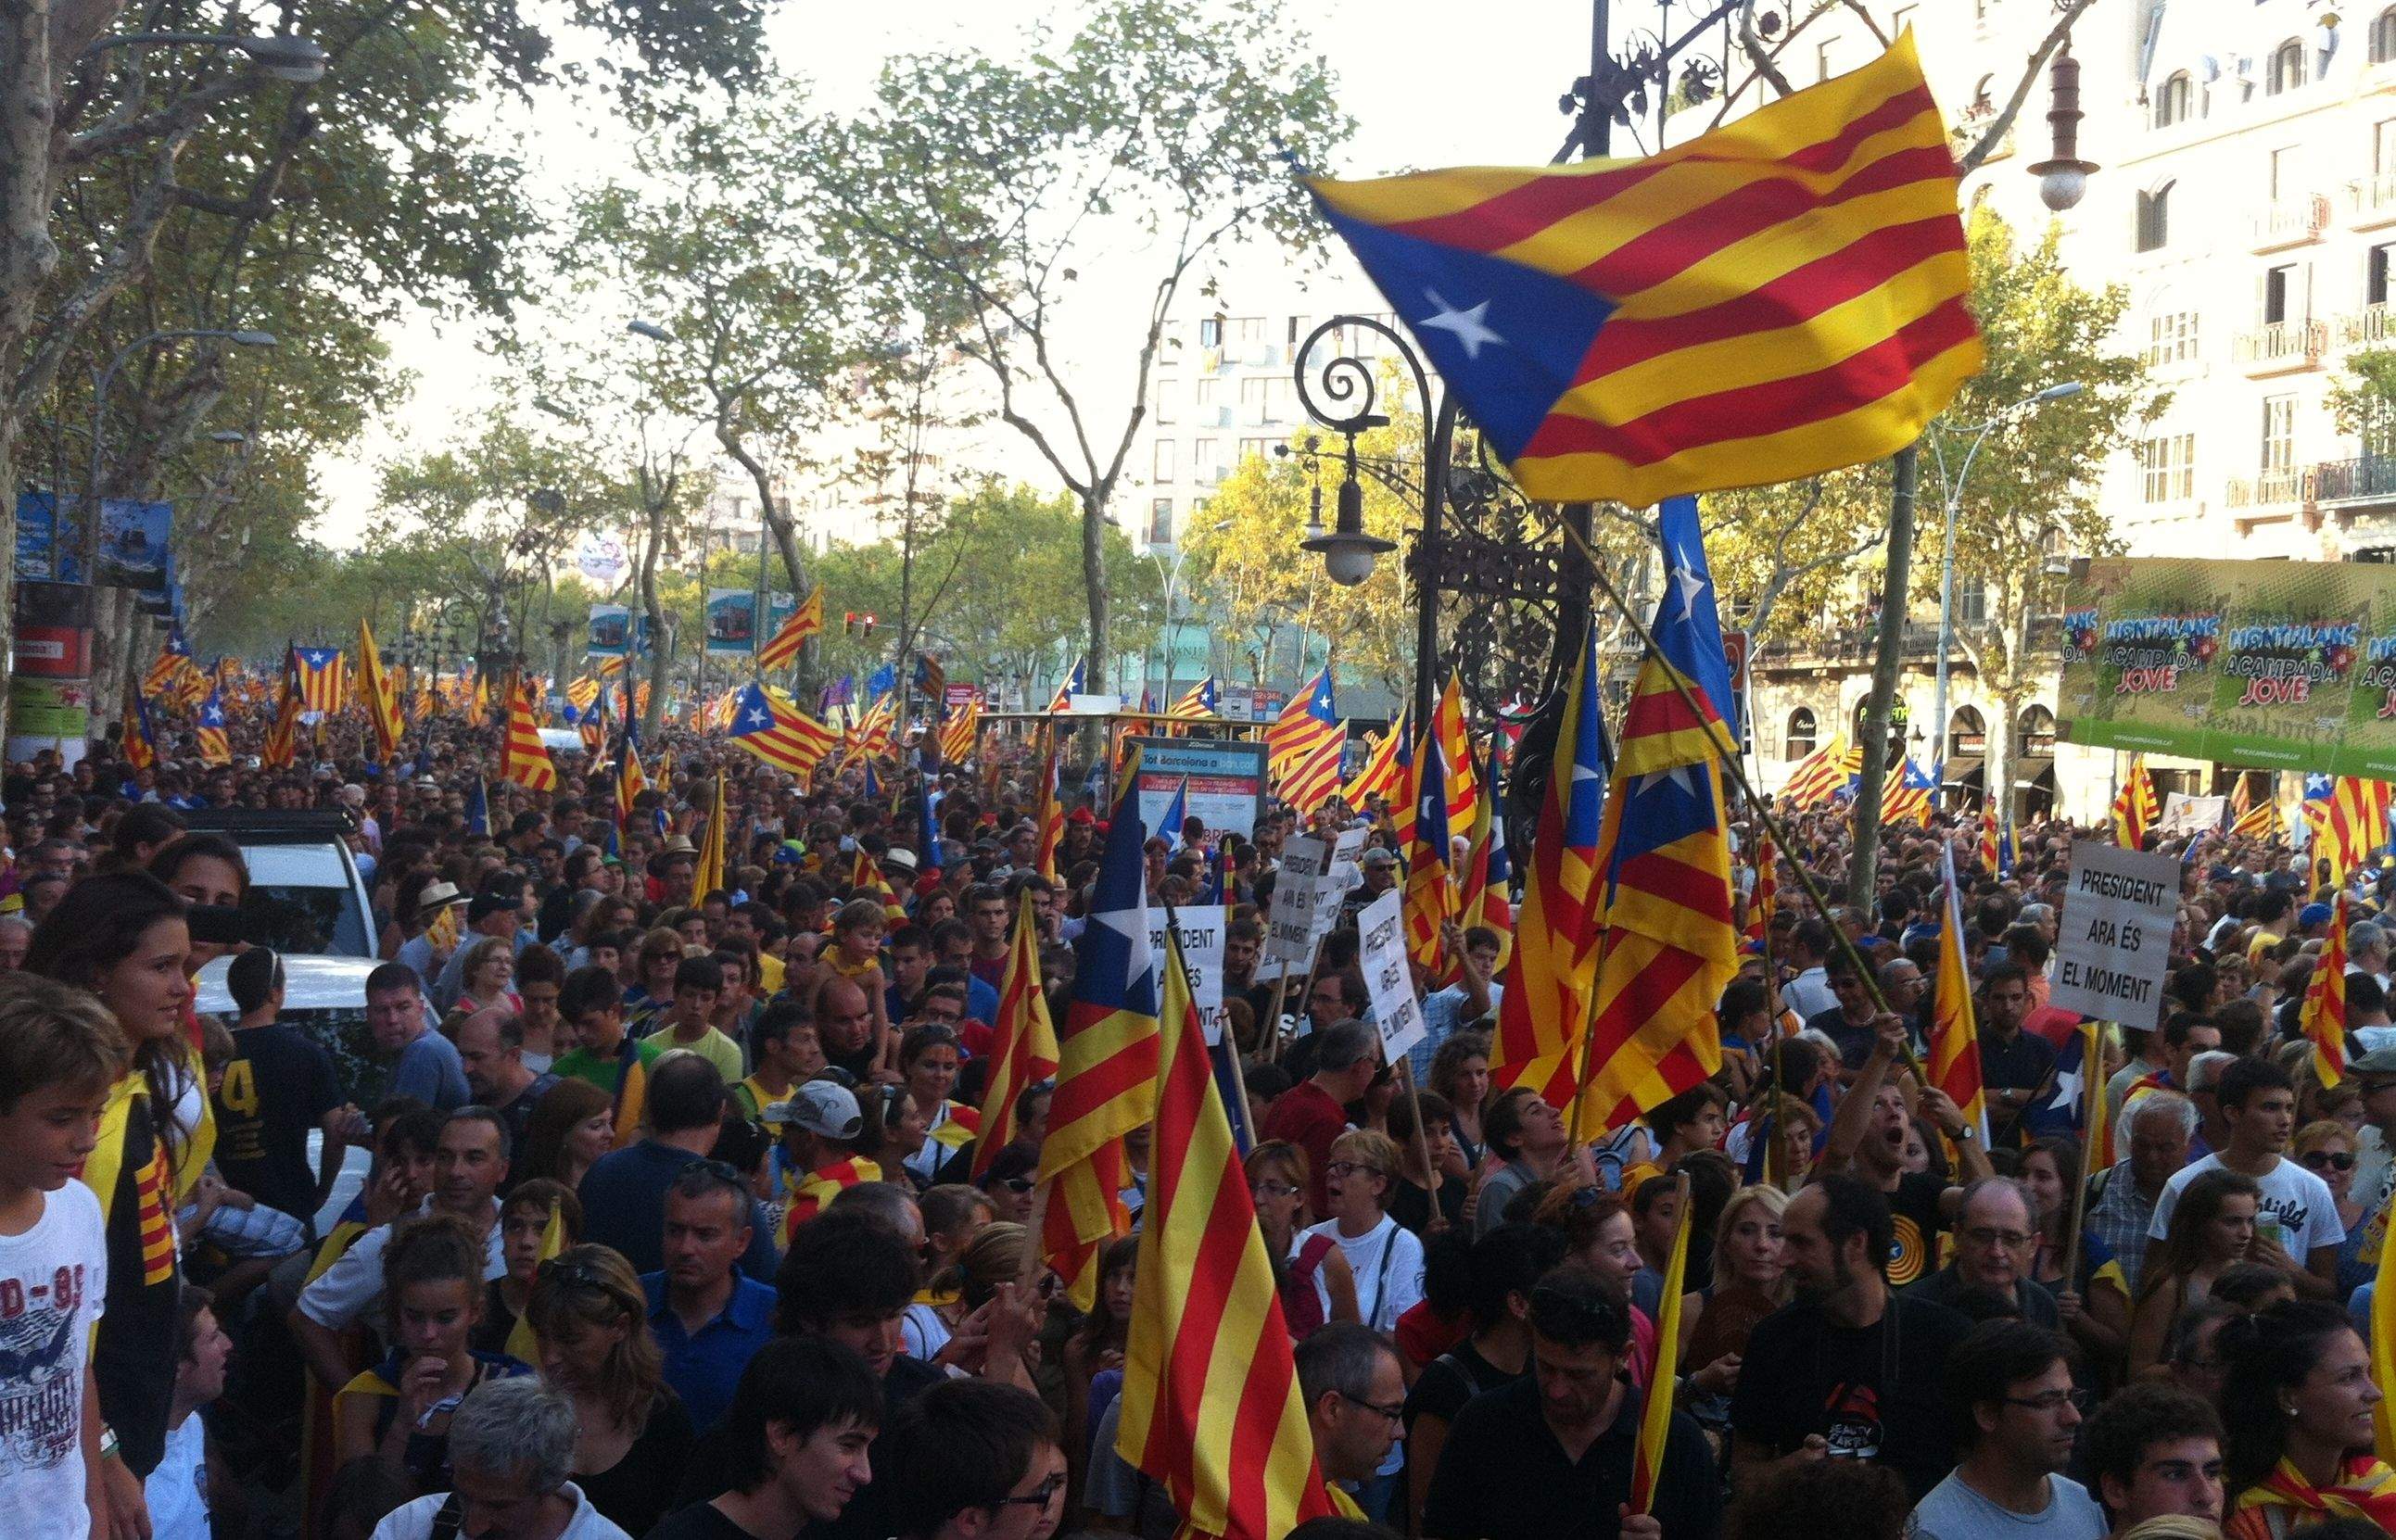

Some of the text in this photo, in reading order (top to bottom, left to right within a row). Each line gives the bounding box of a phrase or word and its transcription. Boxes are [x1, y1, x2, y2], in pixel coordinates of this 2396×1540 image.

[2102, 645, 2203, 673] ACAMPADA
[2225, 654, 2338, 683] ACAMPADA
[2114, 663, 2179, 694] JOVE
[2238, 675, 2312, 707] JOVE
[1160, 755, 1209, 768] Barcelona
[2080, 867, 2167, 907] PRESIDENT
[2086, 918, 2143, 953] ARA ÉS
[2061, 961, 2152, 1004] EL MOMENT
